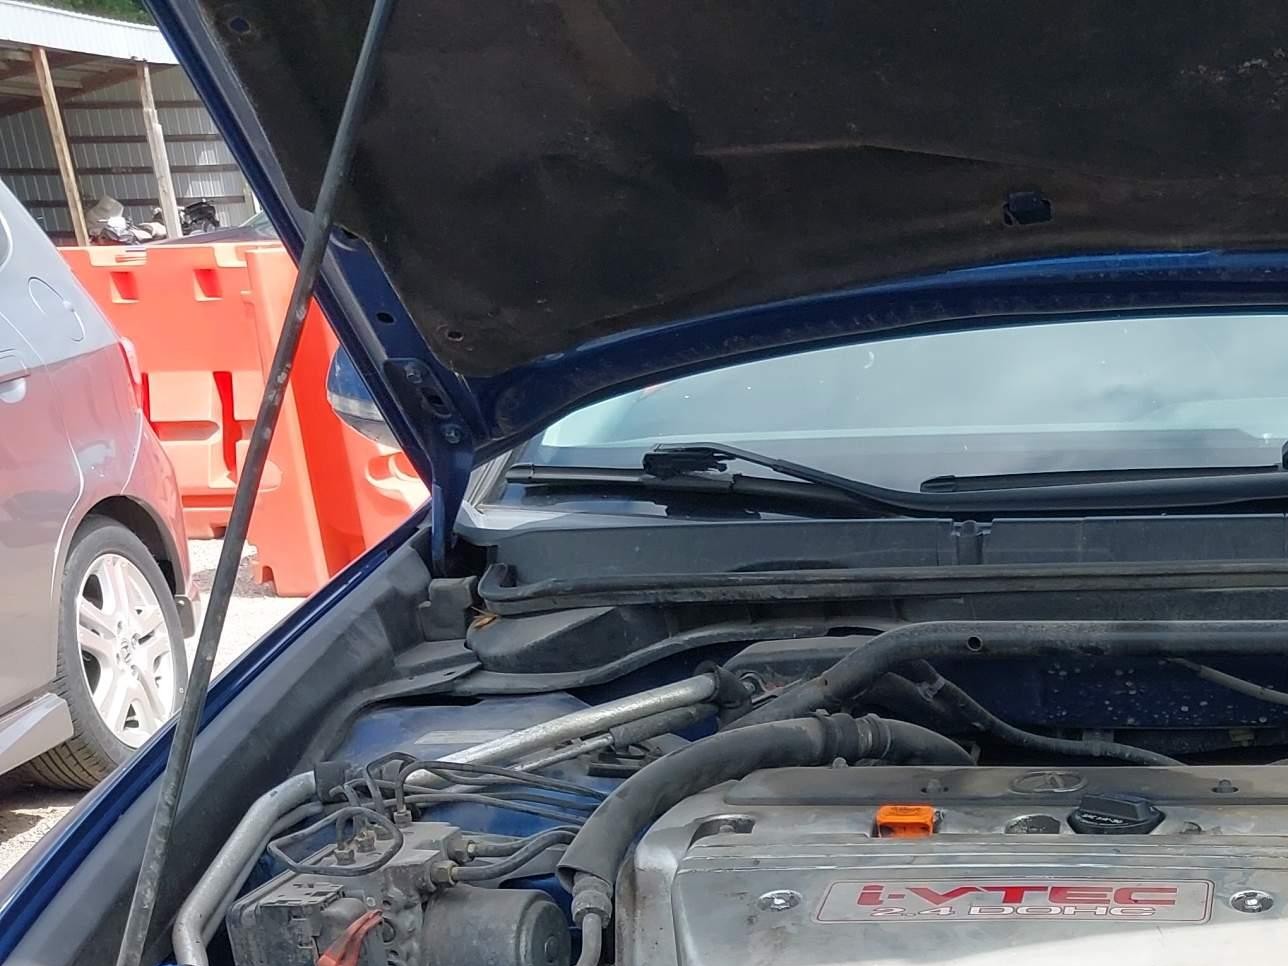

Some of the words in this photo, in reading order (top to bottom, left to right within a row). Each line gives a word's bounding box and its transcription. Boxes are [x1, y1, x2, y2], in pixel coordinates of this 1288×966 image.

[856, 884, 1178, 906] i-VTEC
[869, 906, 953, 917] 2.4
[967, 905, 1157, 917] DOHC
